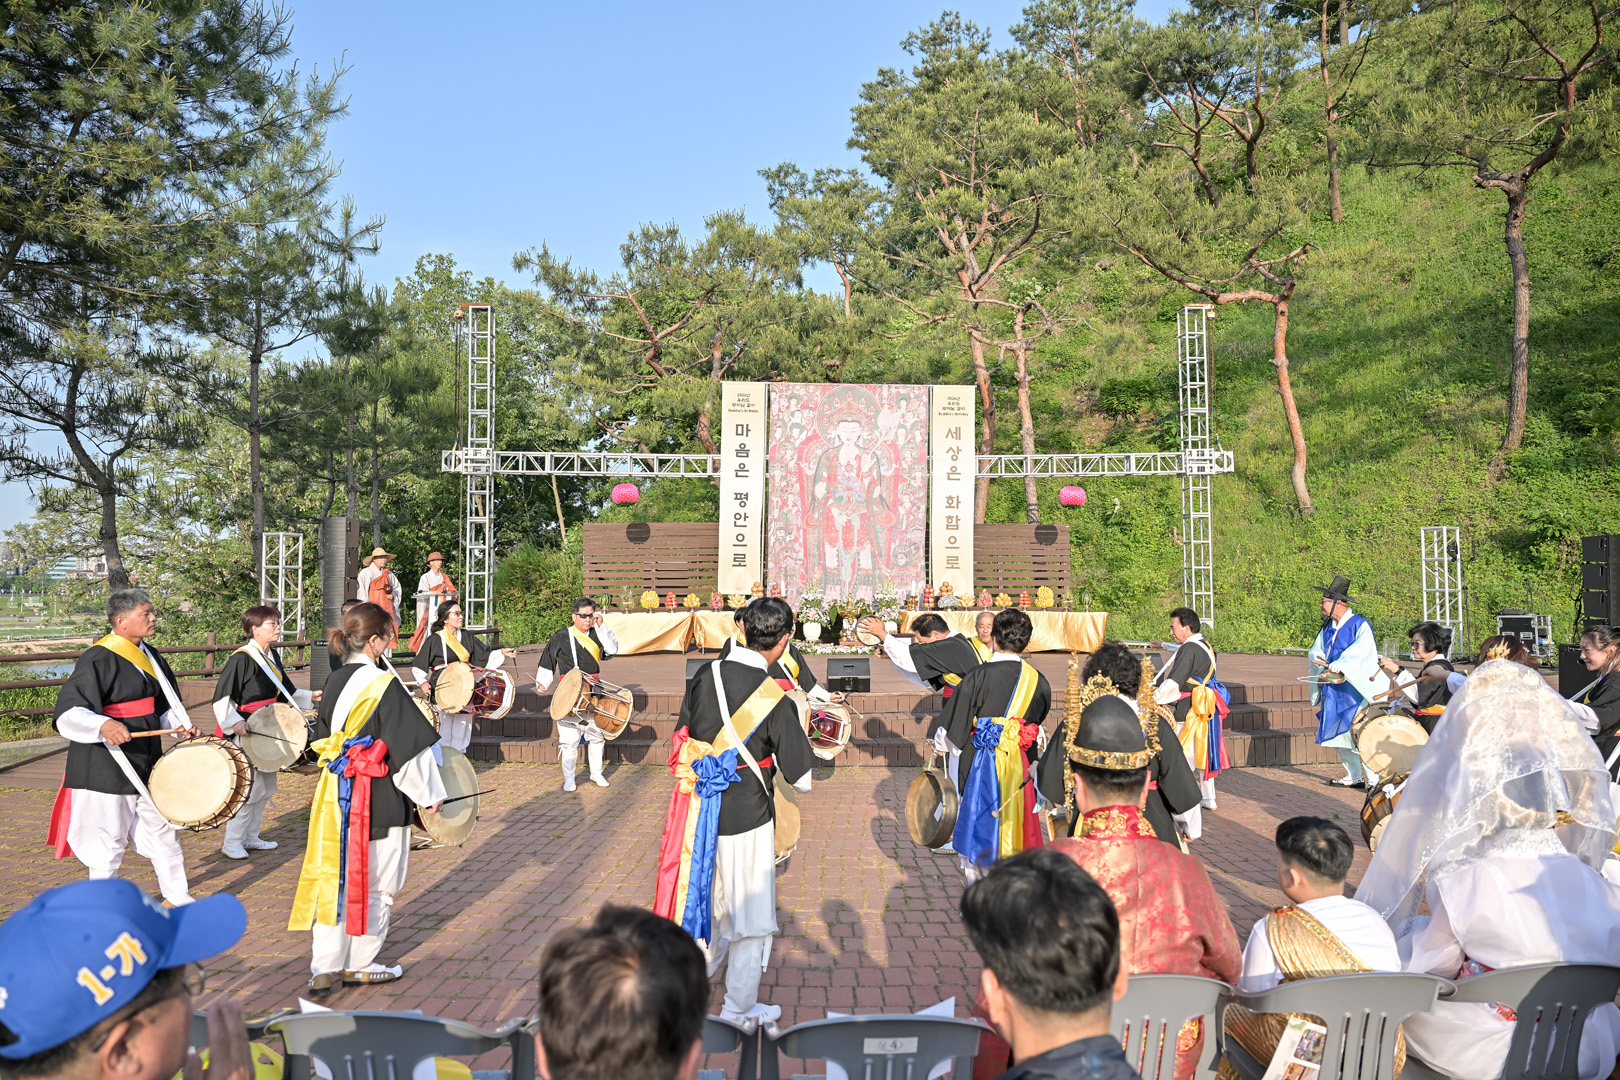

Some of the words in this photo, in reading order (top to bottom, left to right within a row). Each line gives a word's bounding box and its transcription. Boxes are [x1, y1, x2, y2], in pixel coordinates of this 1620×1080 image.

[734, 423, 751, 478] 마음은
[945, 426, 962, 481] 세상은
[732, 491, 749, 567] 평안으로
[945, 494, 961, 570] 화합으로
[76, 931, 148, 1006] 1-가
